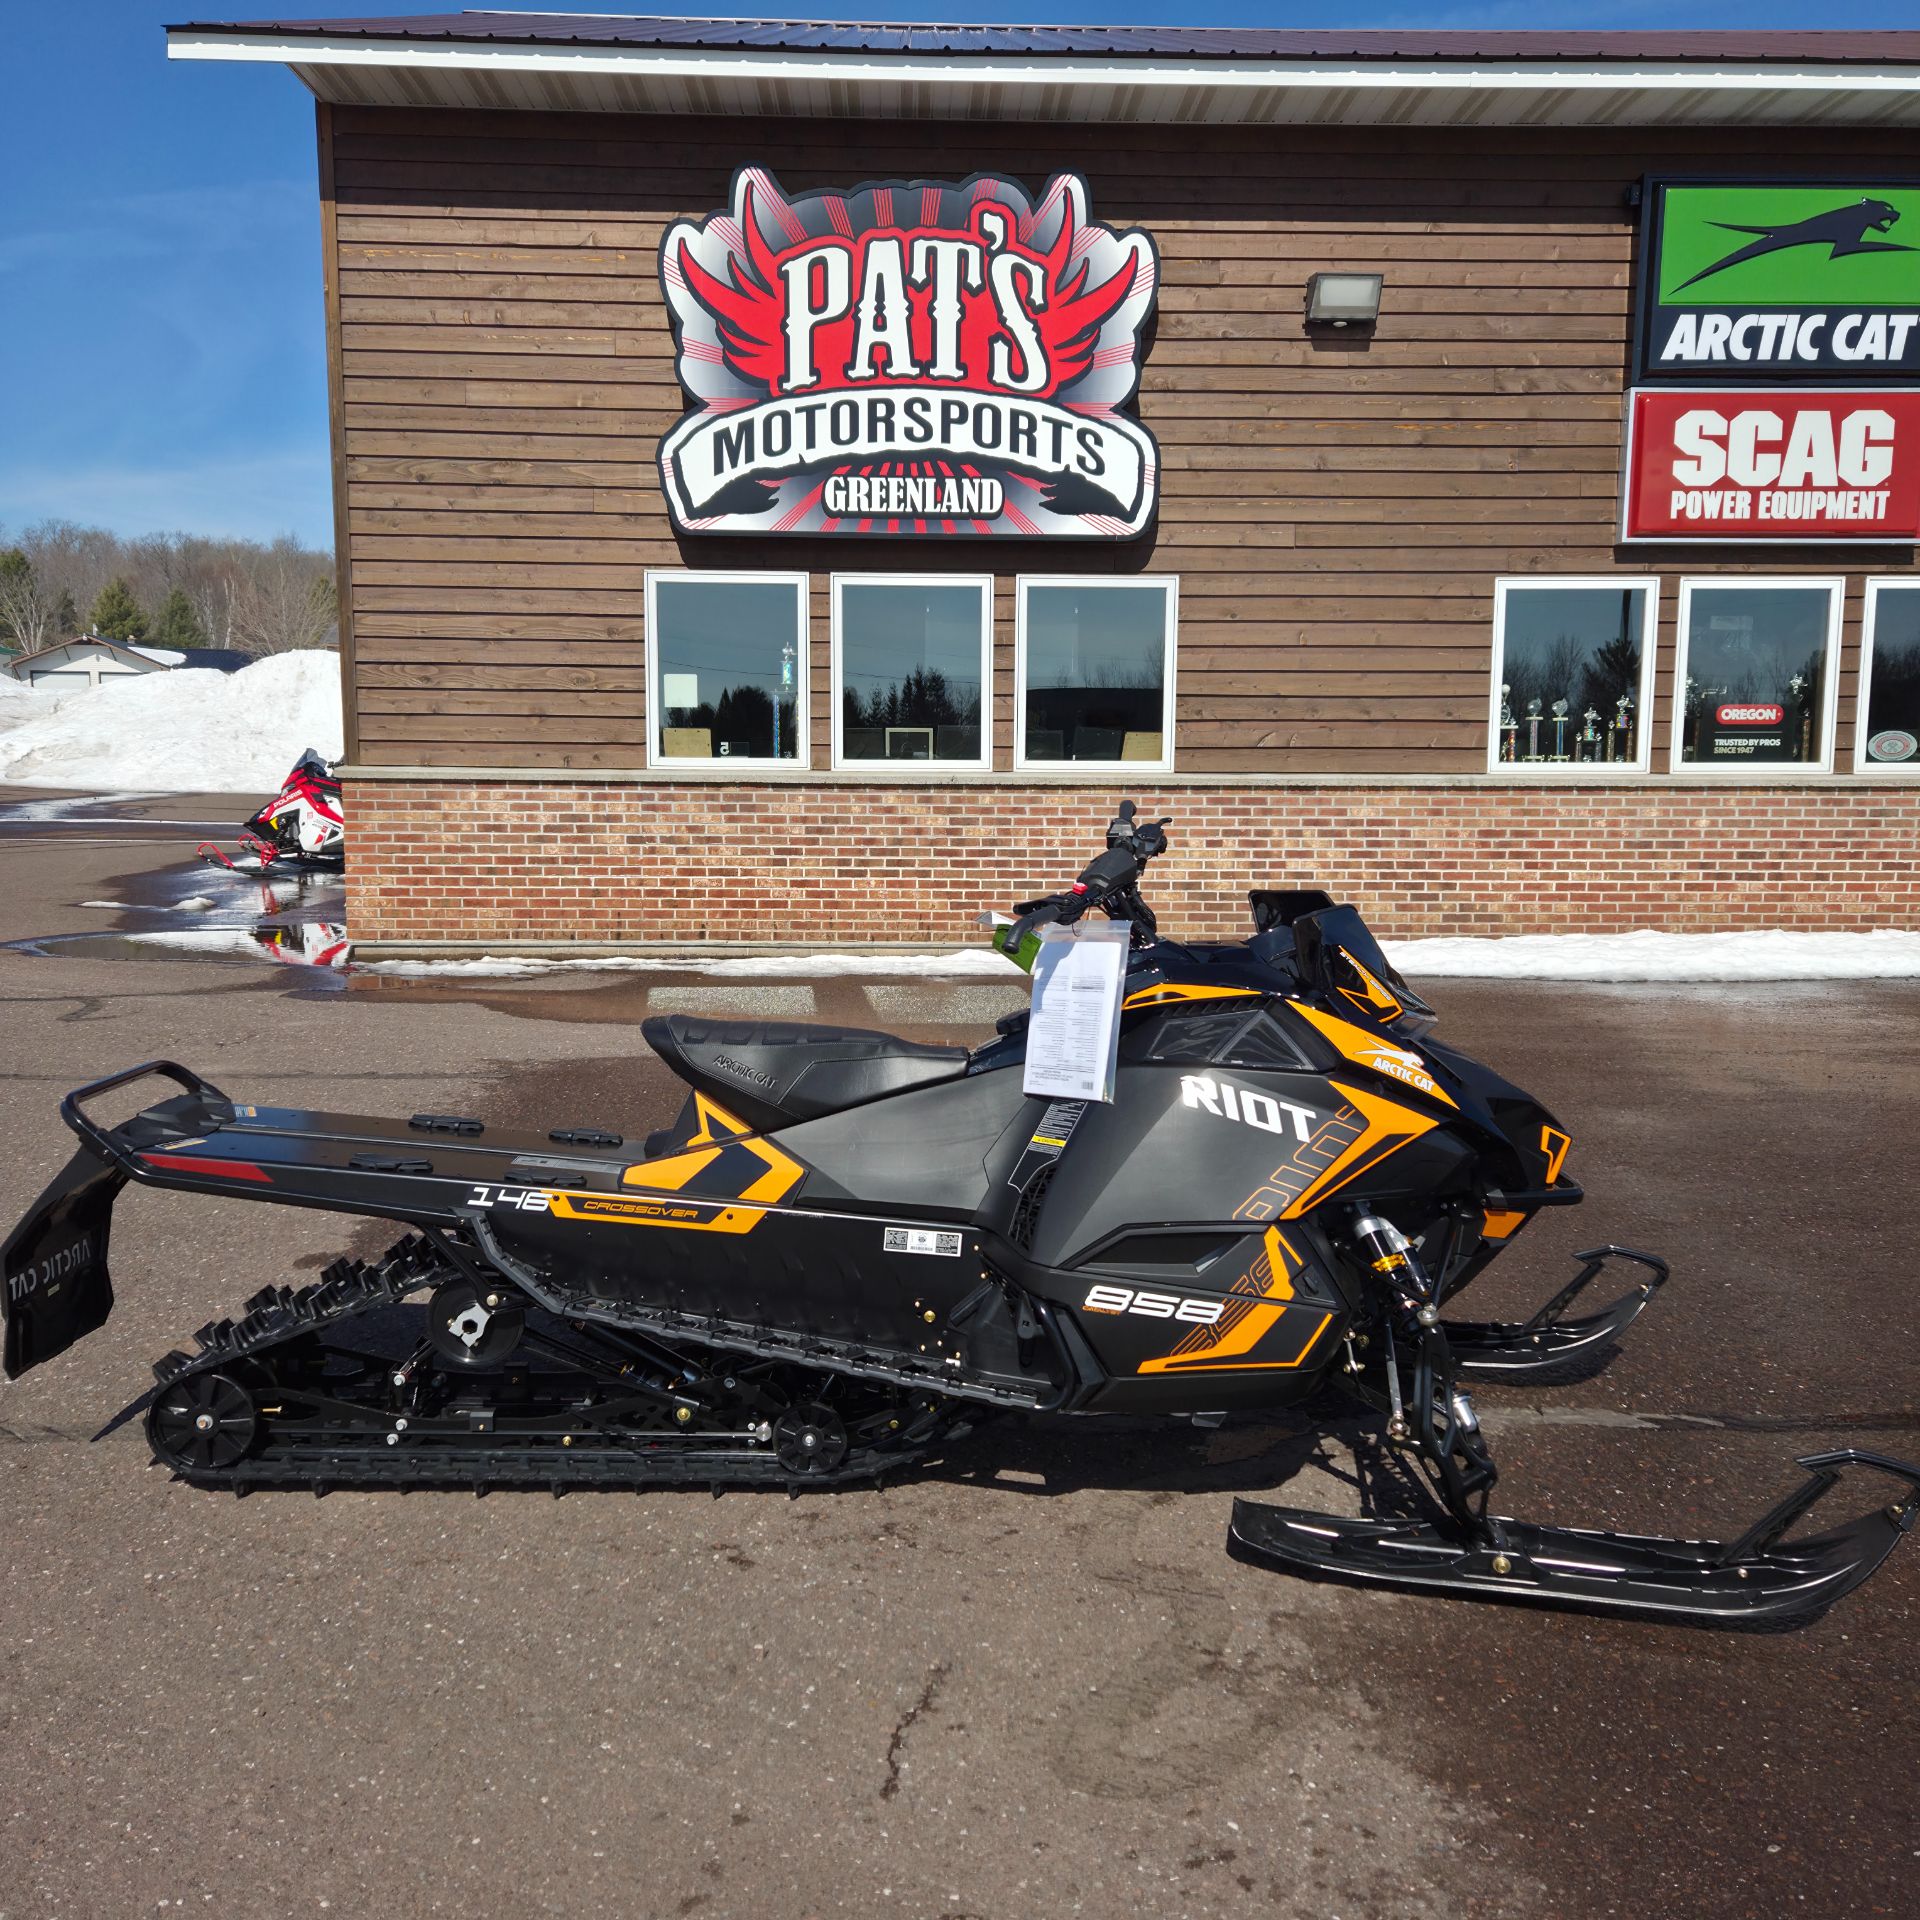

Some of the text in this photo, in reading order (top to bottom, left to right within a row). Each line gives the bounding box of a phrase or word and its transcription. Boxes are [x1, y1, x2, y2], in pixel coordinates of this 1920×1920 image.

[782, 211, 1051, 393] PAT'S
[1660, 313, 1919, 361] ARCTIC CAT
[712, 396, 1107, 478] MOTORSPORTS
[1672, 409, 1896, 487] SCAG
[824, 474, 1004, 515] GREENLAND
[1670, 490, 1891, 520] POWER EQUIPMENT
[1721, 708, 1777, 721] OREGON
[1713, 746, 1755, 754] SINCE 1947
[1714, 738, 1781, 747] TRUSTED BY PROS
[273, 789, 303, 809] POLARIS
[712, 1054, 755, 1080] ARCTIC
[1372, 1056, 1435, 1092] ARCTIC CAT
[1180, 1074, 1317, 1144] RIOT
[466, 1186, 552, 1212] 146
[583, 1200, 699, 1219] CROSSOVER
[1084, 1285, 1225, 1325] 858
